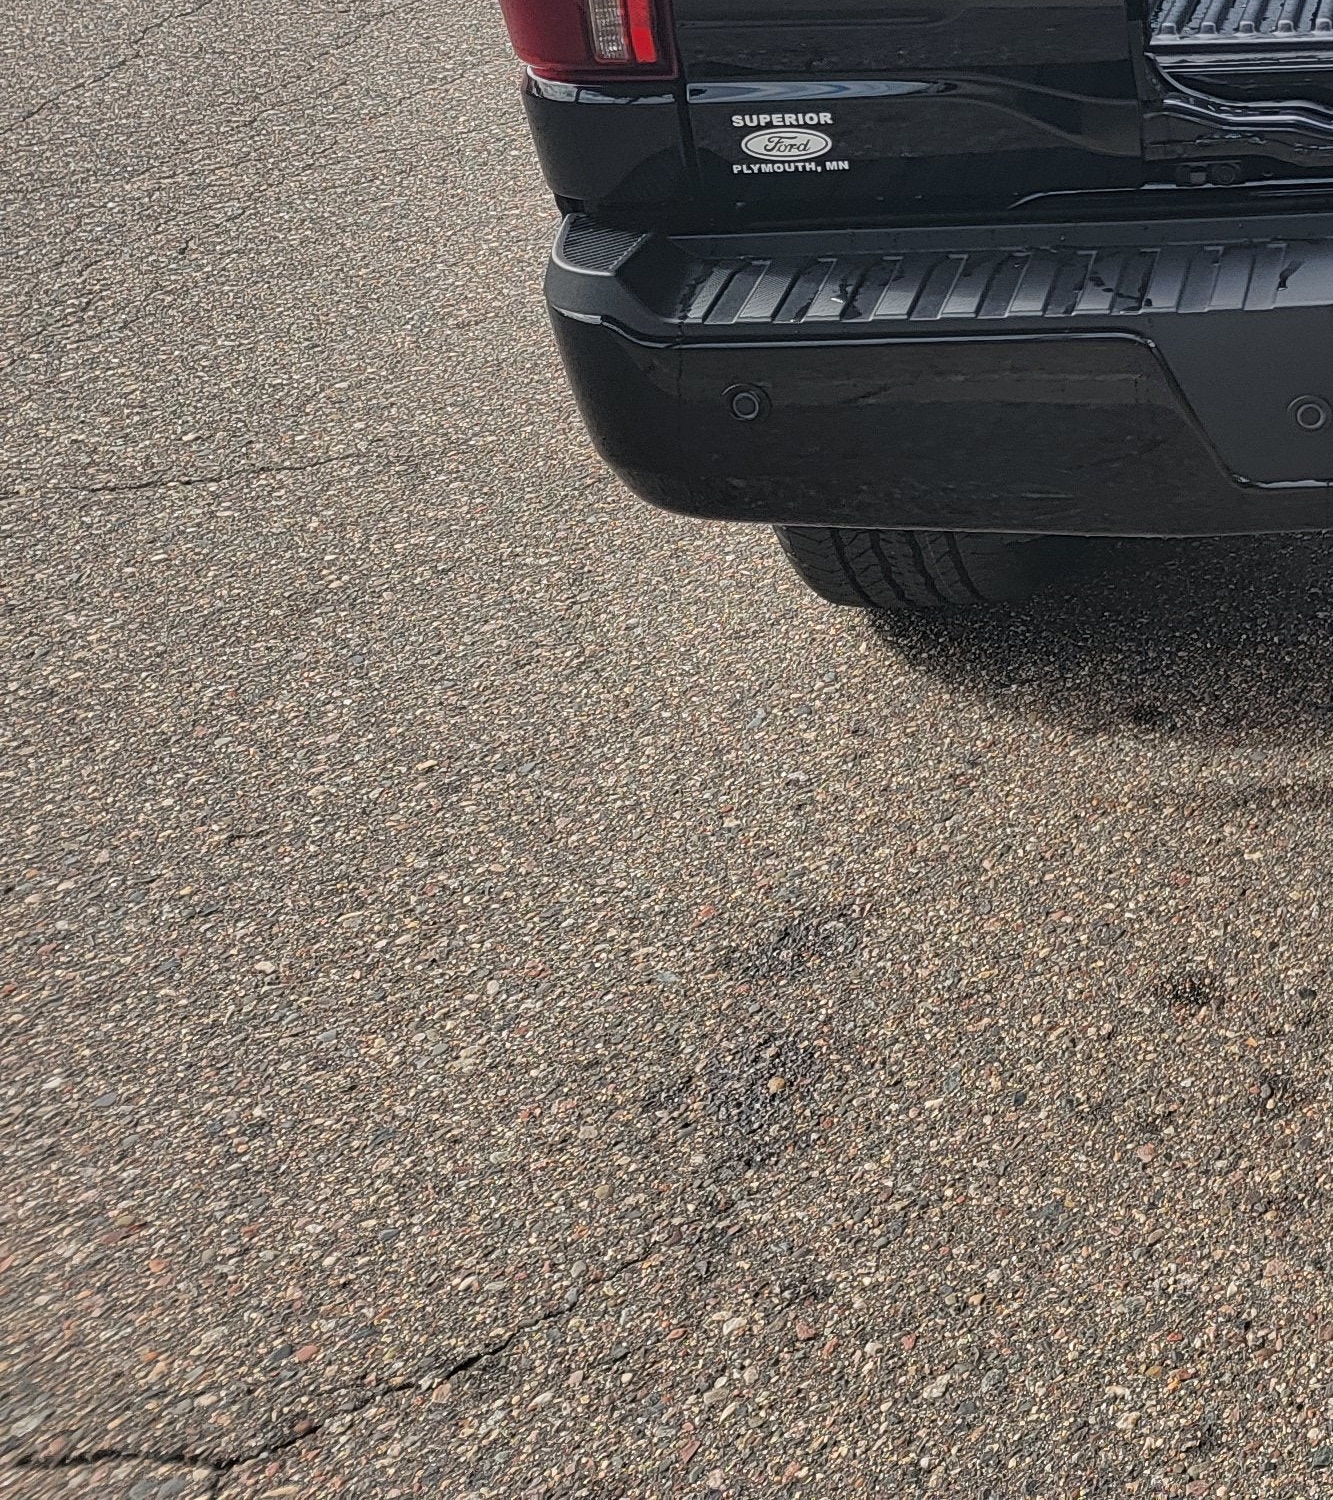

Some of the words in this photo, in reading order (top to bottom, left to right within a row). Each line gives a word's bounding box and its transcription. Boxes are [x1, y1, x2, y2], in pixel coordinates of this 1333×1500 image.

[731, 112, 834, 127] SUPERIOR
[764, 135, 811, 153] Ford
[732, 162, 822, 174] PLYMOUTH,
[826, 161, 849, 171] MN
